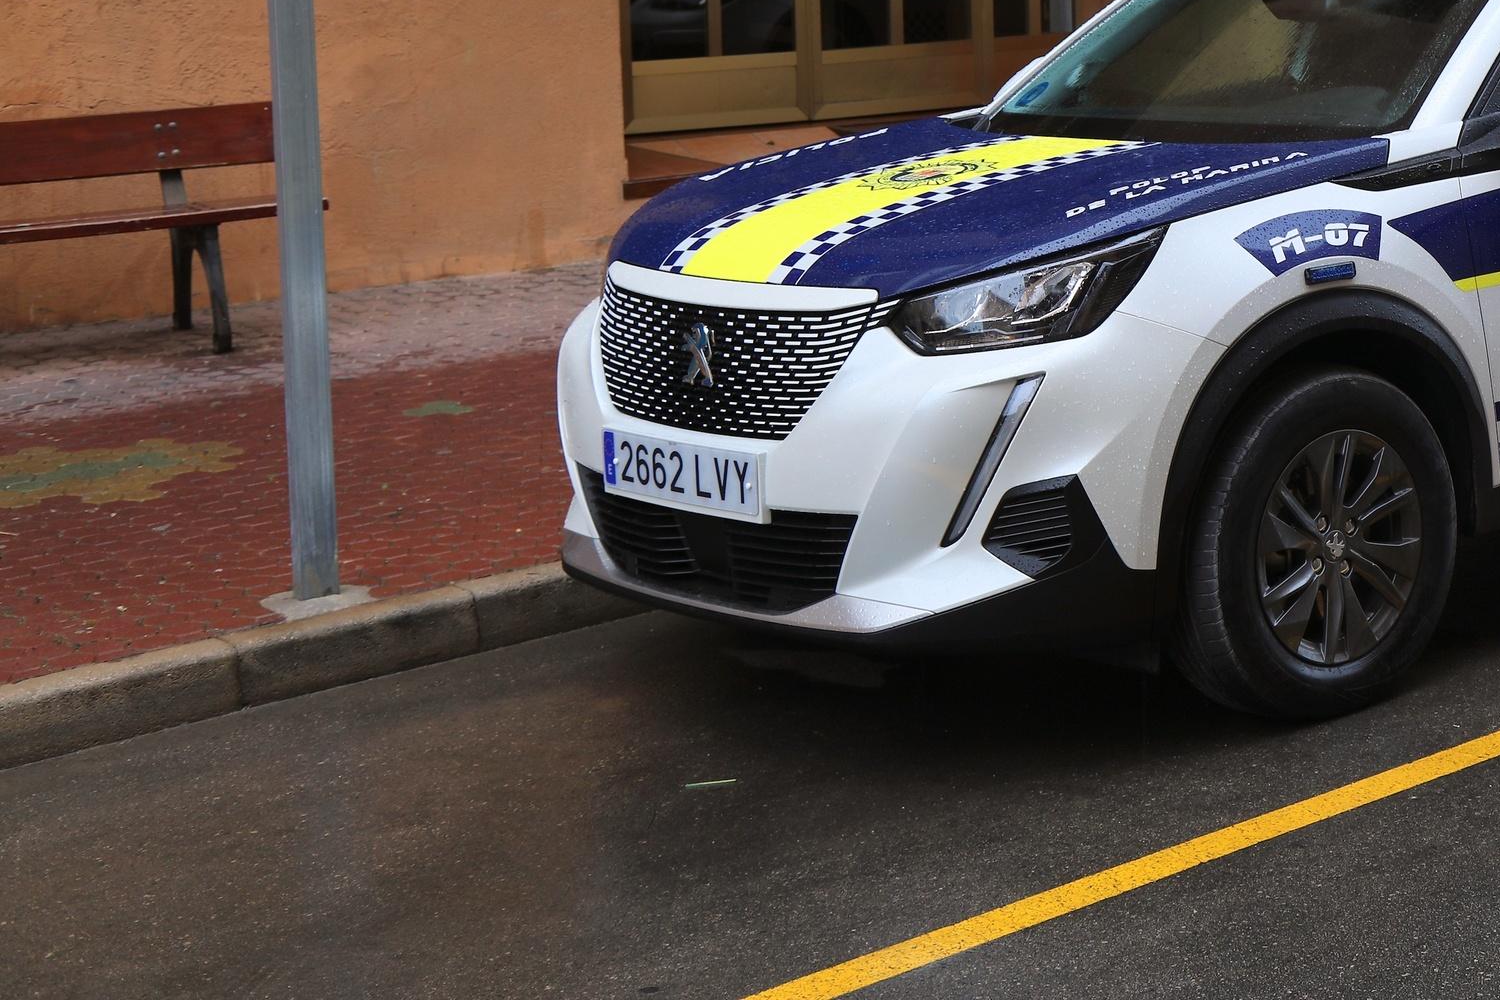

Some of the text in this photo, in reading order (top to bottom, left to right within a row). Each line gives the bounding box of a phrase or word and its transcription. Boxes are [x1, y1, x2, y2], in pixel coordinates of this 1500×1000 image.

[1125, 184, 1167, 200] LA
[1181, 151, 1309, 185] MARINA
[1268, 222, 1370, 264] M-07
[620, 440, 749, 504] 2662 LVY
